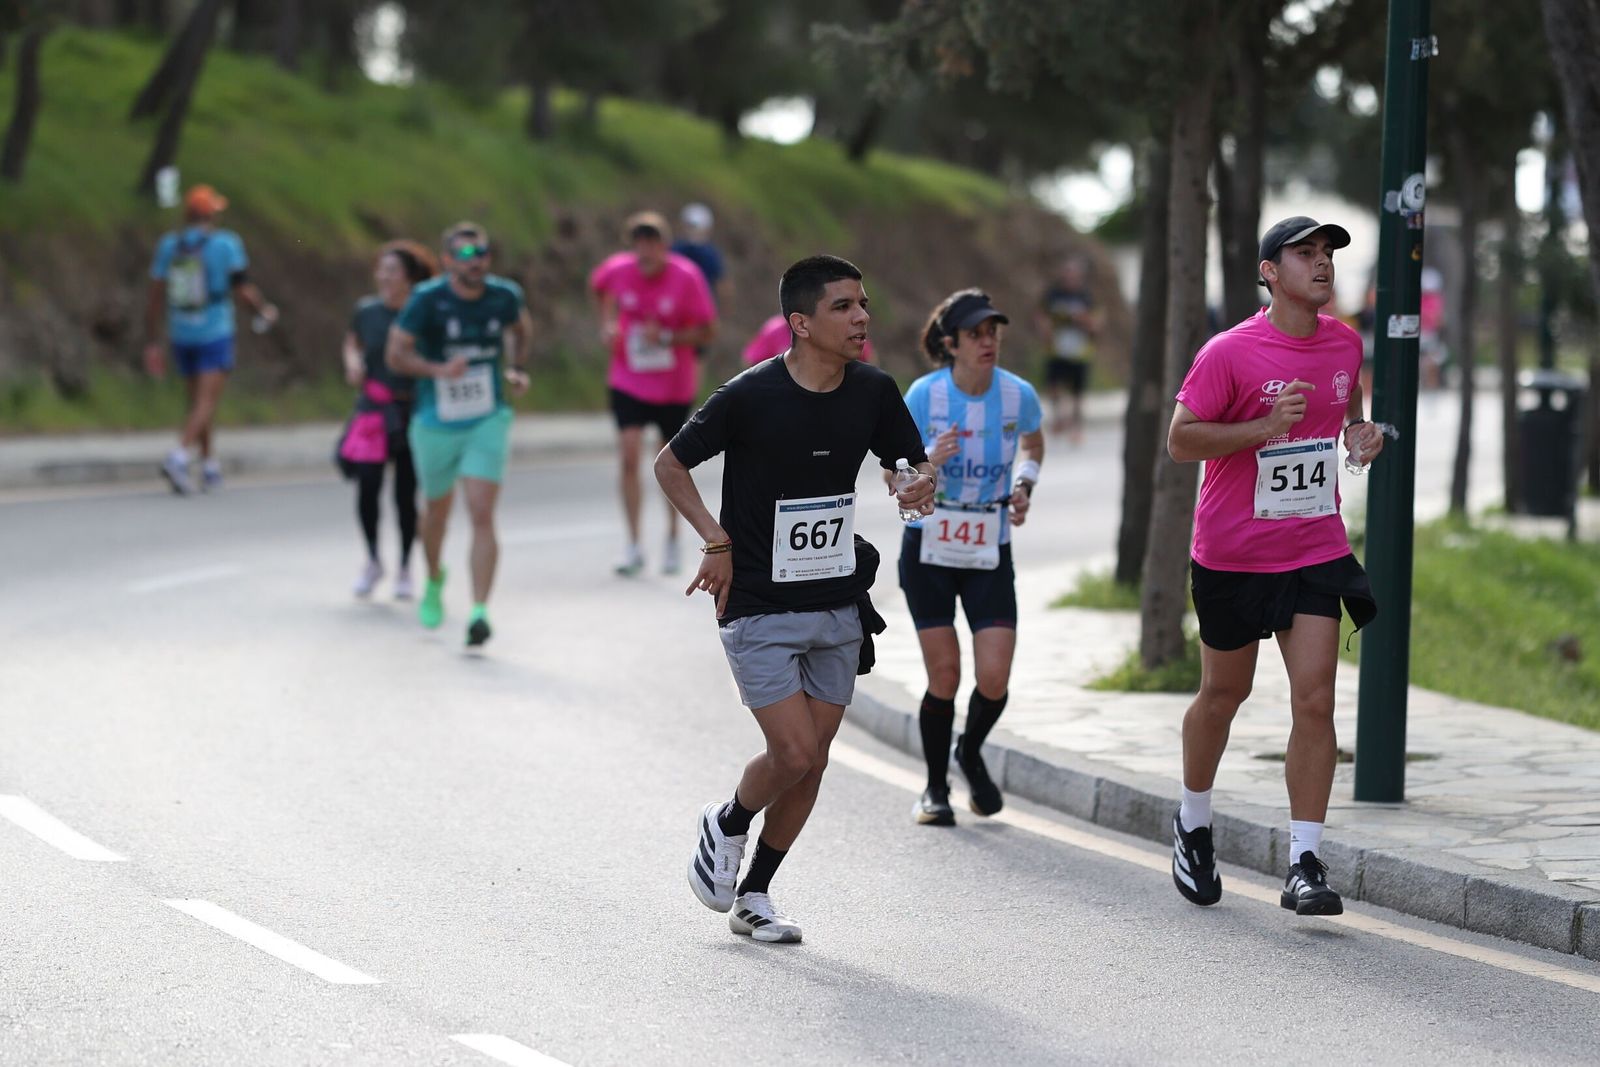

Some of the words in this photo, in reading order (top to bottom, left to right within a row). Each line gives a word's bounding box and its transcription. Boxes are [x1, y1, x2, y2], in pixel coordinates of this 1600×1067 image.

[1270, 461, 1326, 492] 514
[789, 517, 844, 551] 667
[937, 519, 987, 546] 141
